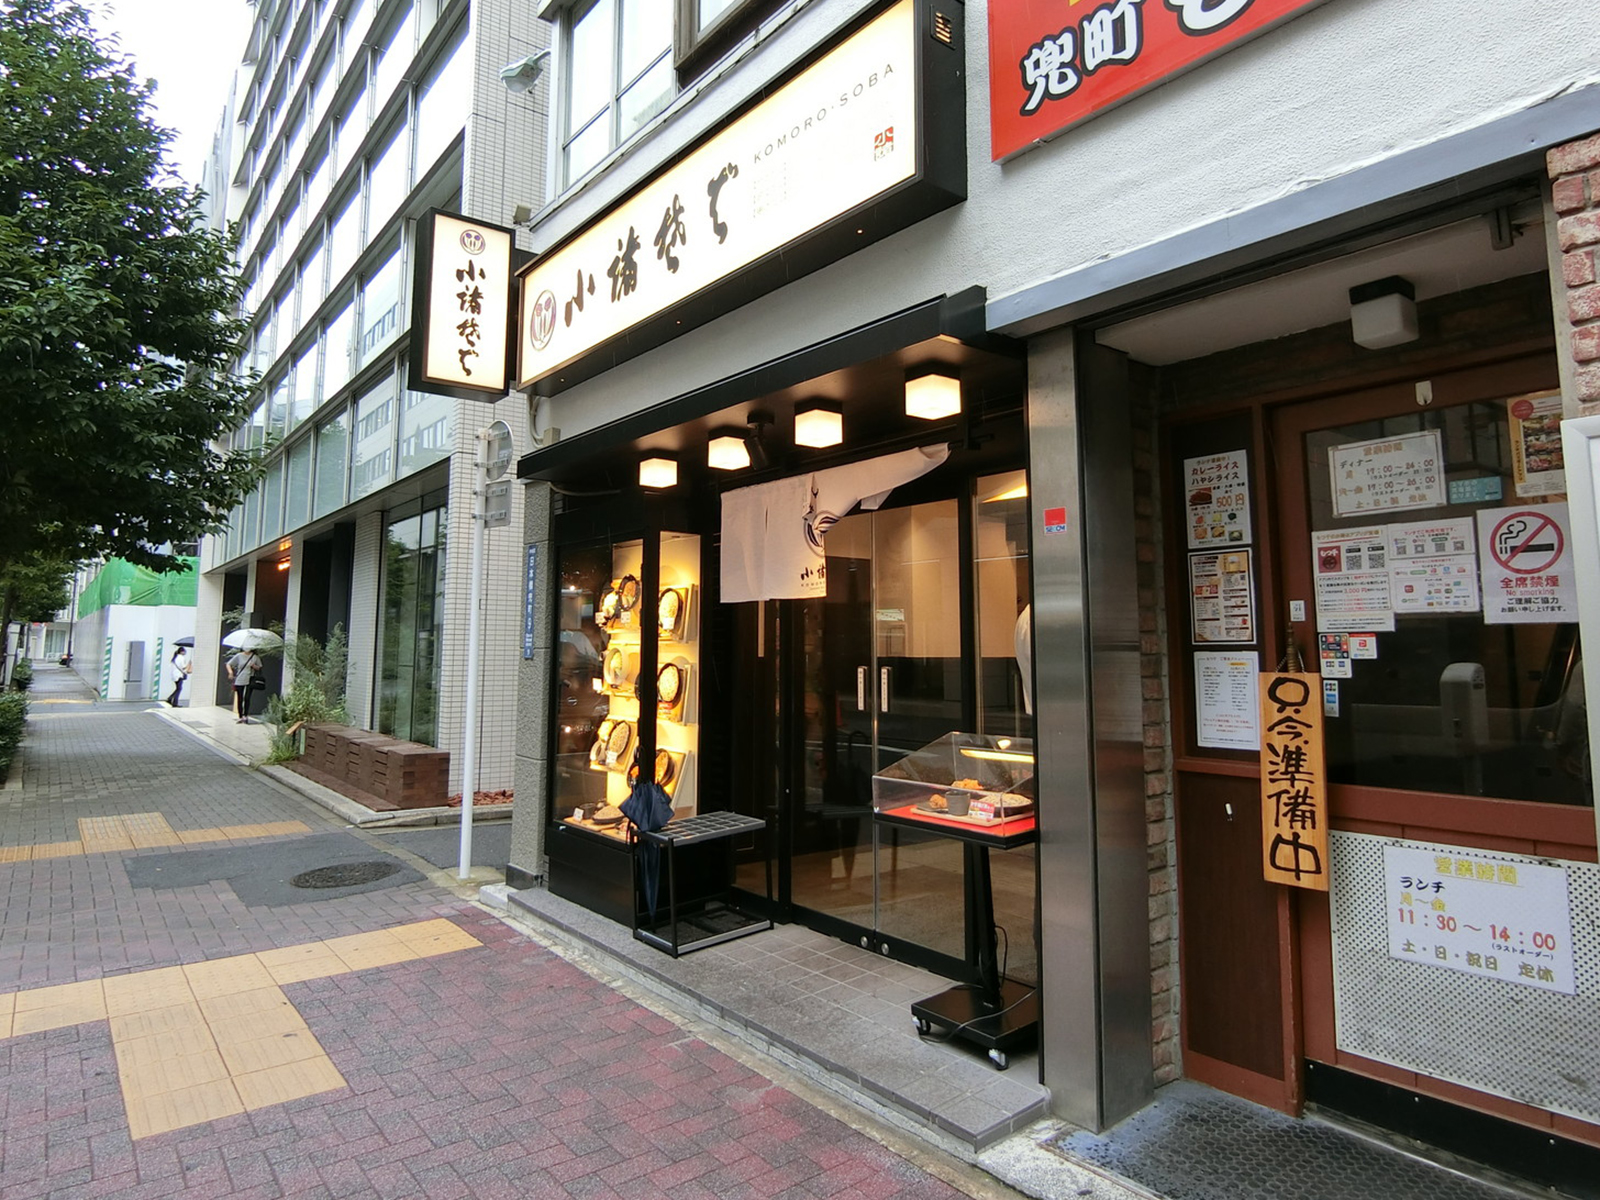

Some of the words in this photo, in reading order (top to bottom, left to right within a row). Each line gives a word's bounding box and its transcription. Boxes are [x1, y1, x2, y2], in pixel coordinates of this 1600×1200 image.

[1191, 460, 1240, 476] カレーライス
[1339, 458, 1374, 470] ディナー
[1191, 471, 1241, 486] ハヤシライス
[1500, 575, 1559, 589] 全席禁煙
[1505, 589, 1516, 597] No
[1507, 596, 1559, 606] ご理解ご協力
[1266, 676, 1323, 882] 只今準備中
[1433, 855, 1519, 885] 営業時間
[1400, 875, 1446, 893] ランチ
[1518, 961, 1556, 983] 定休
